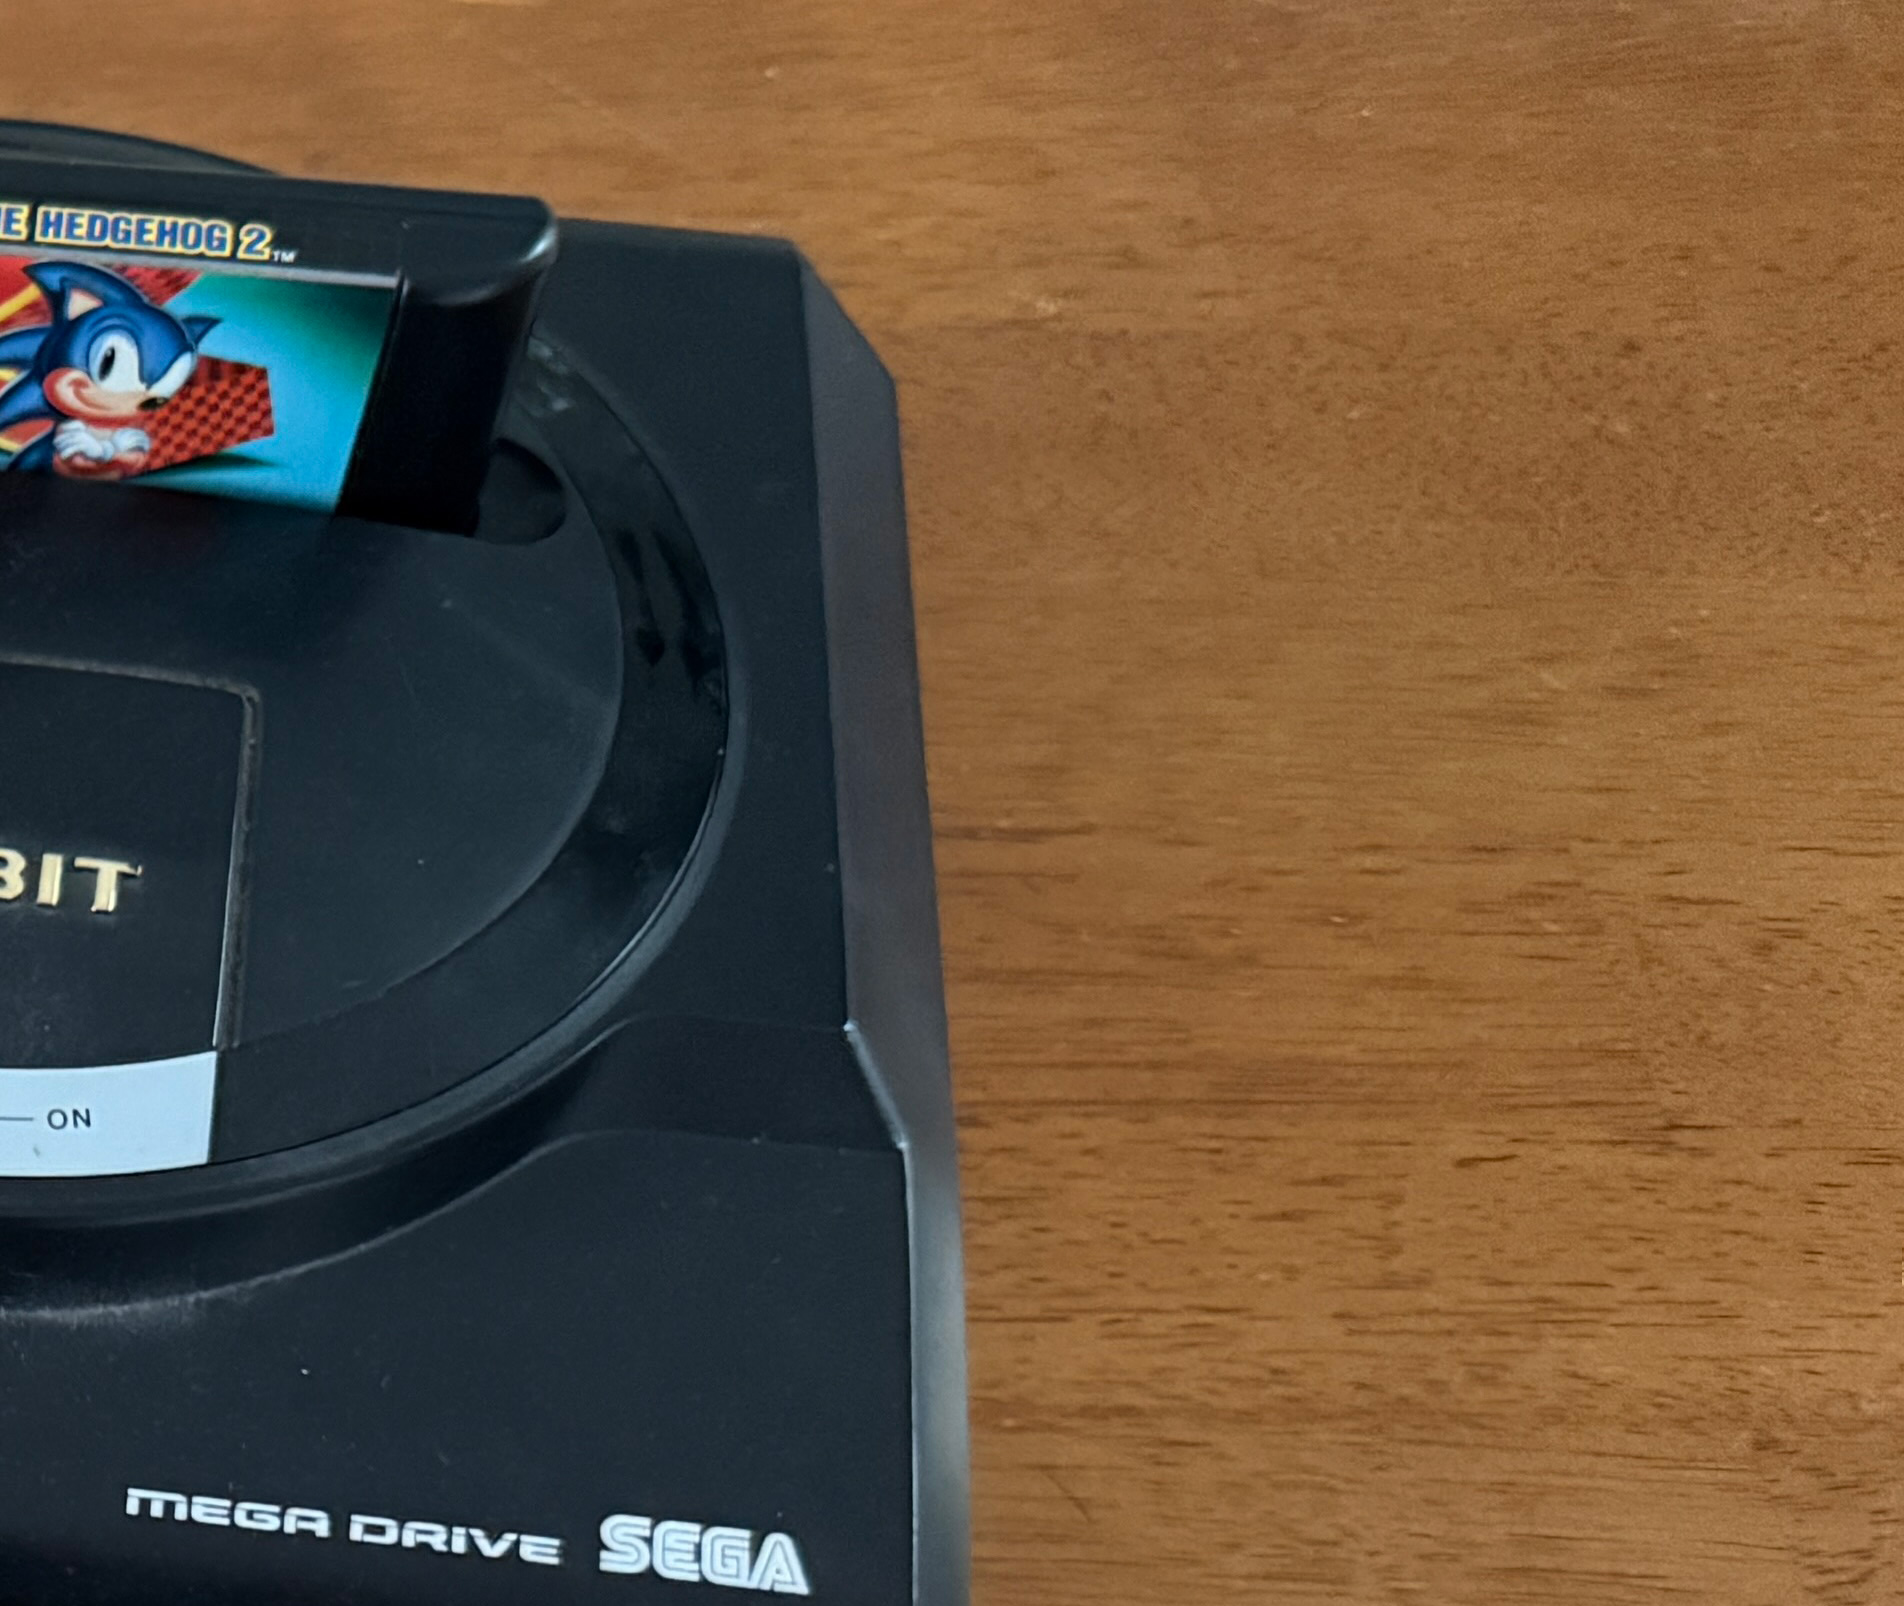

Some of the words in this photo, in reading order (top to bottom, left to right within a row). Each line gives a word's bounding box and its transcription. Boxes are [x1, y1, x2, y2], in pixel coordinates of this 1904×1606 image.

[35, 205, 233, 259] HEDGEHOG
[235, 224, 272, 261] 2
[47, 1108, 92, 1131] ON
[125, 1487, 332, 1539] MEGA
[349, 1513, 562, 1566] DRIVE
[600, 1513, 811, 1596] SEGA
